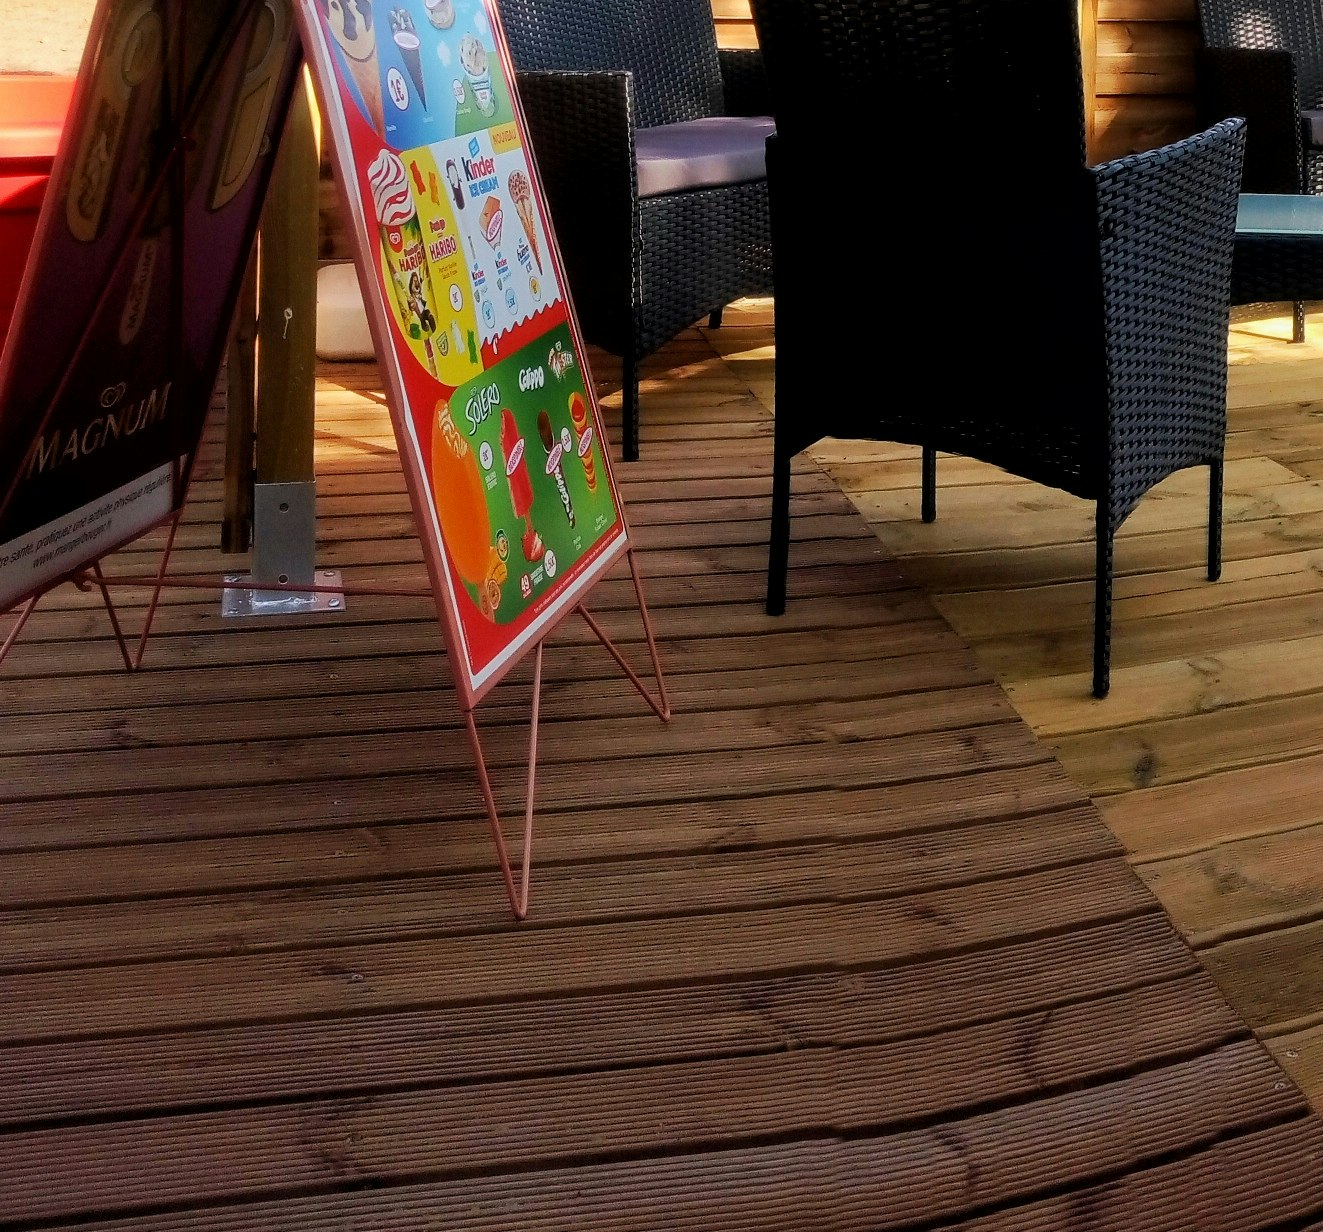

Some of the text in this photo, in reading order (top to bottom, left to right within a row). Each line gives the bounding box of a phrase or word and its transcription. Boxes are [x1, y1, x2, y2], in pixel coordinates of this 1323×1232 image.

[492, 129, 517, 145] NOUVEAU
[429, 236, 457, 261] HARIBO
[465, 382, 500, 436] SOLERO
[27, 381, 173, 481] MAGNUM
